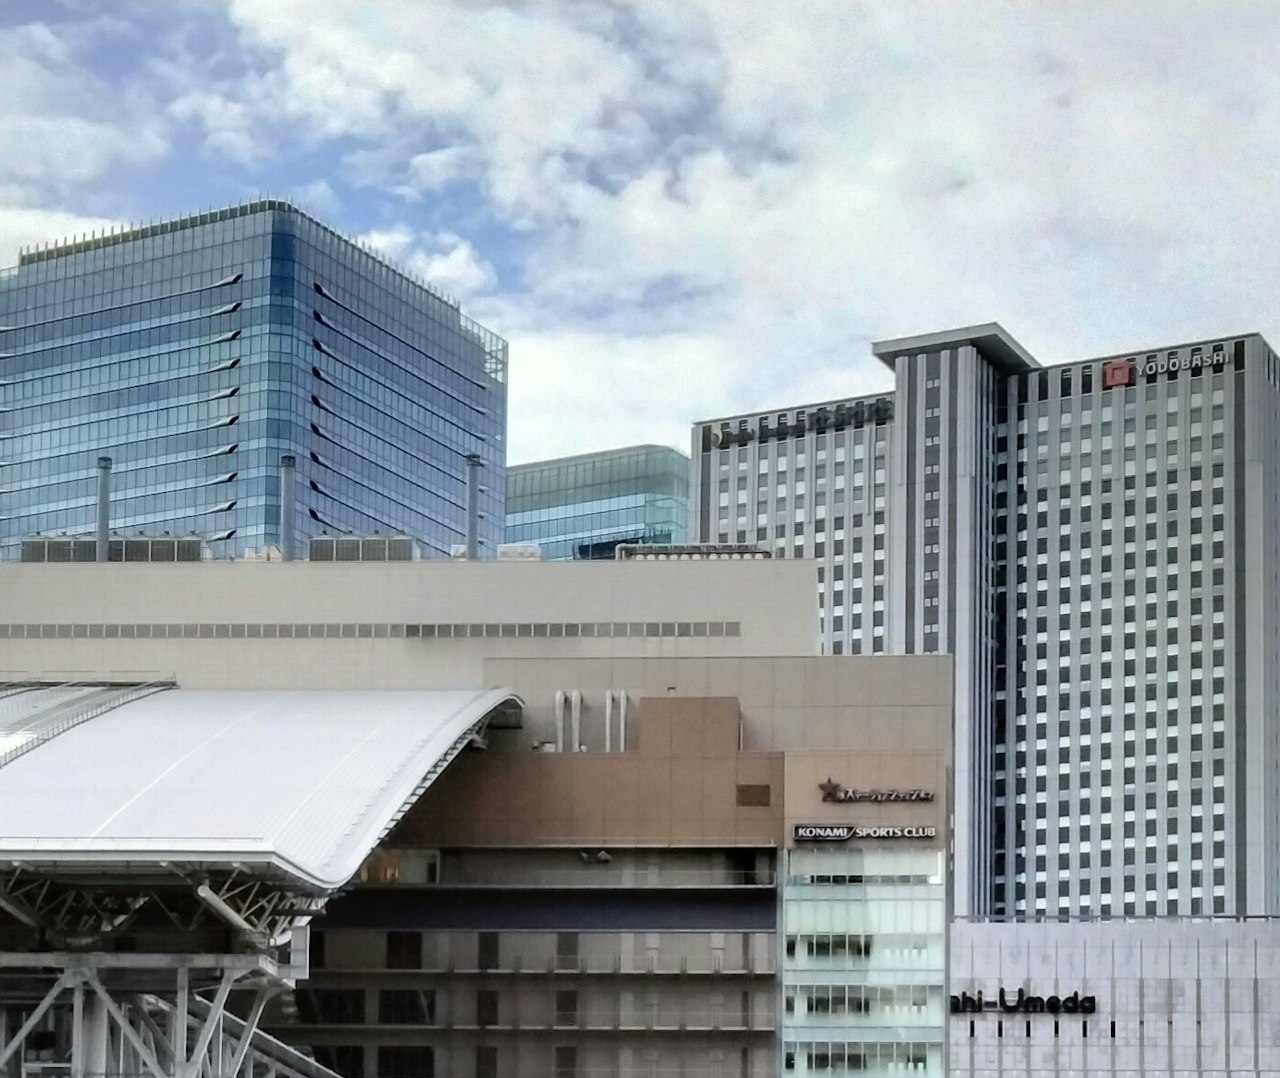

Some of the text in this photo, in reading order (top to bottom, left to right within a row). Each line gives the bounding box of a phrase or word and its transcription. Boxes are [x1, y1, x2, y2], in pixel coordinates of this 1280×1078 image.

[1136, 352, 1229, 376] YODOBASHI
[797, 827, 936, 837] KONAMI SPORTS CLUB
